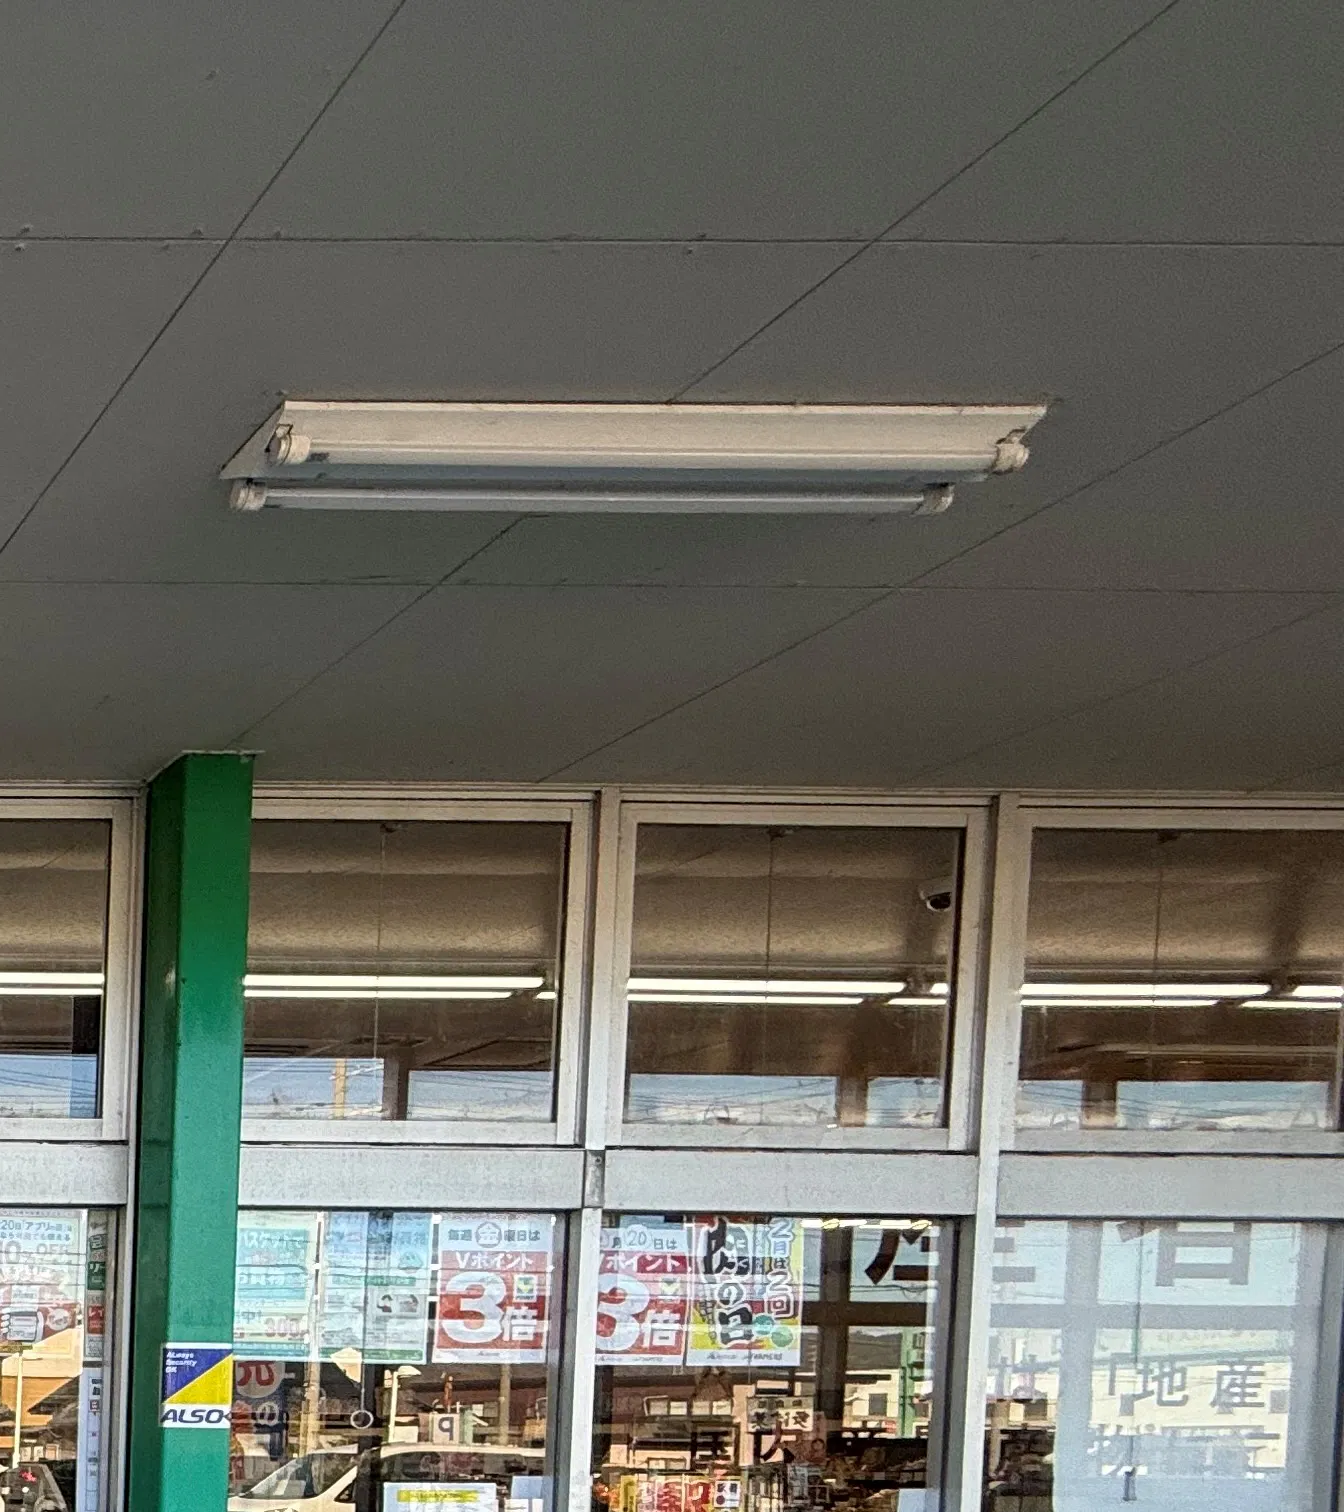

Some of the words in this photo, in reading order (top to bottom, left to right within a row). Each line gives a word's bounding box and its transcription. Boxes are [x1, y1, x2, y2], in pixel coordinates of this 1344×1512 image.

[455, 1252, 534, 1269] Vポイント
[441, 1272, 538, 1343] 3倍
